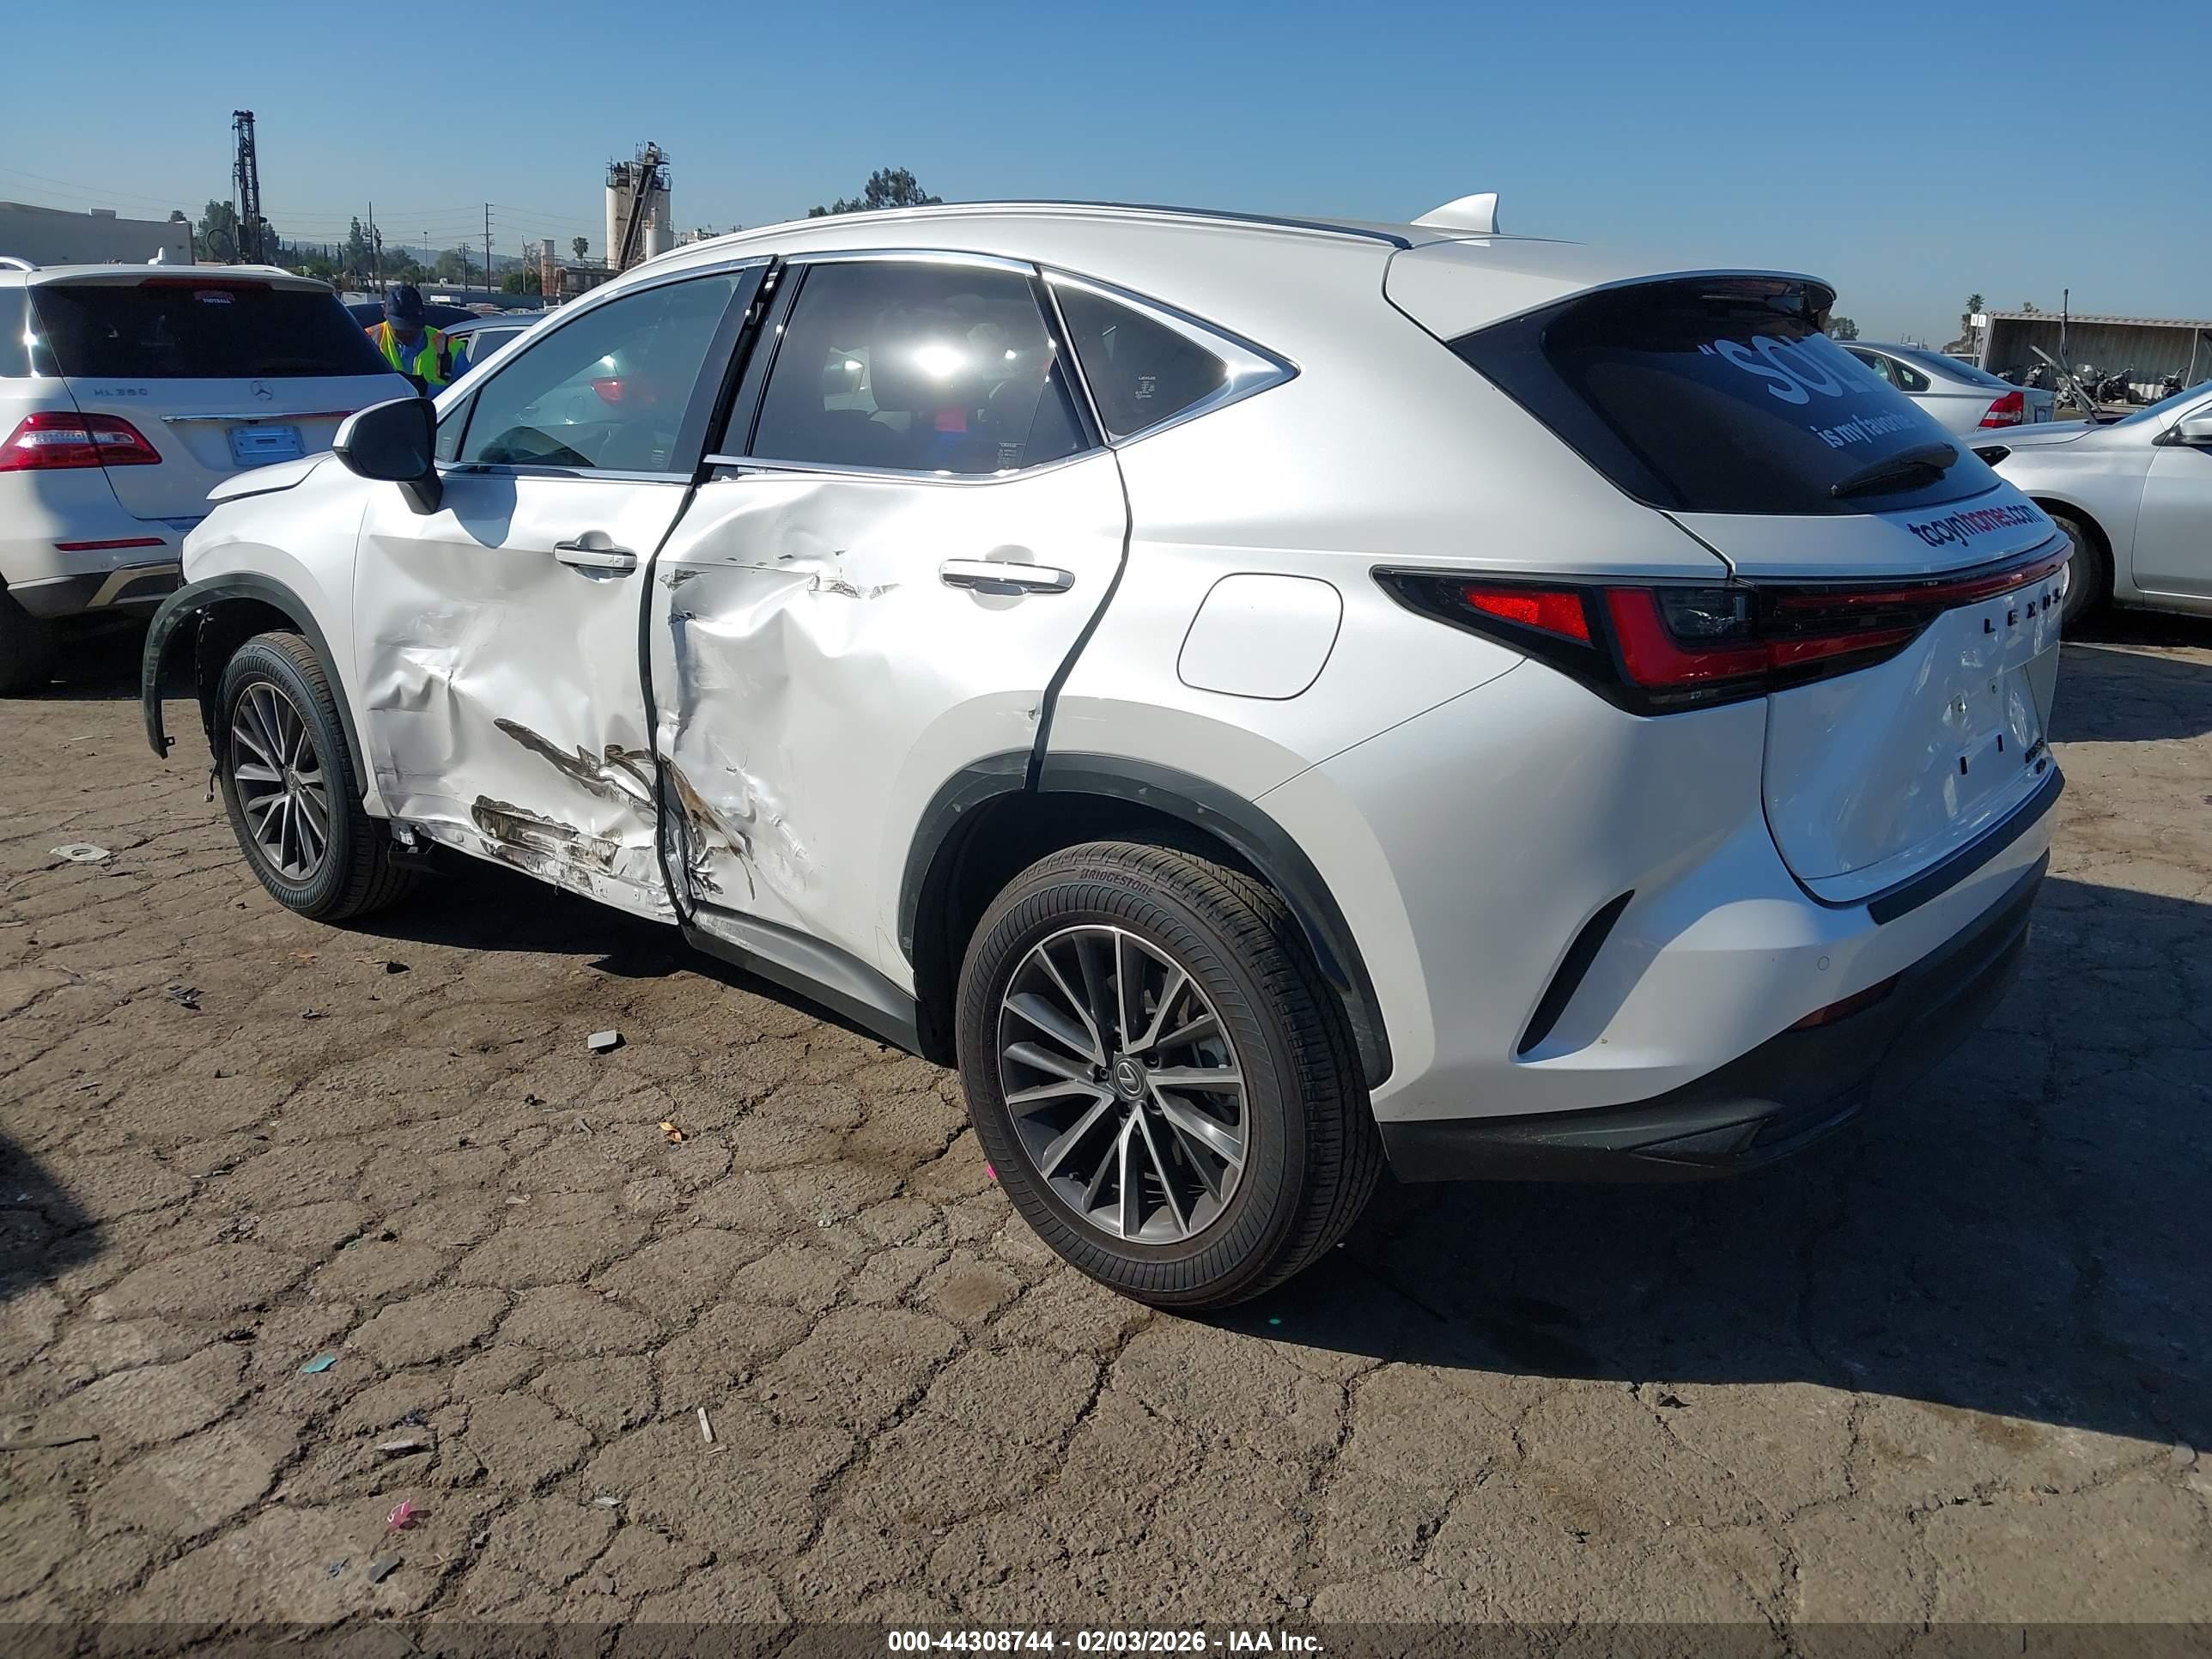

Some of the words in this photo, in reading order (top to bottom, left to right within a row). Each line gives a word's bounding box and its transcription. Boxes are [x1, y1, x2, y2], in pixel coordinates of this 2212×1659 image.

[1810, 426, 1844, 448] is
[1833, 422, 1872, 444] my
[1079, 867, 1155, 896] BRIDGESTONE
